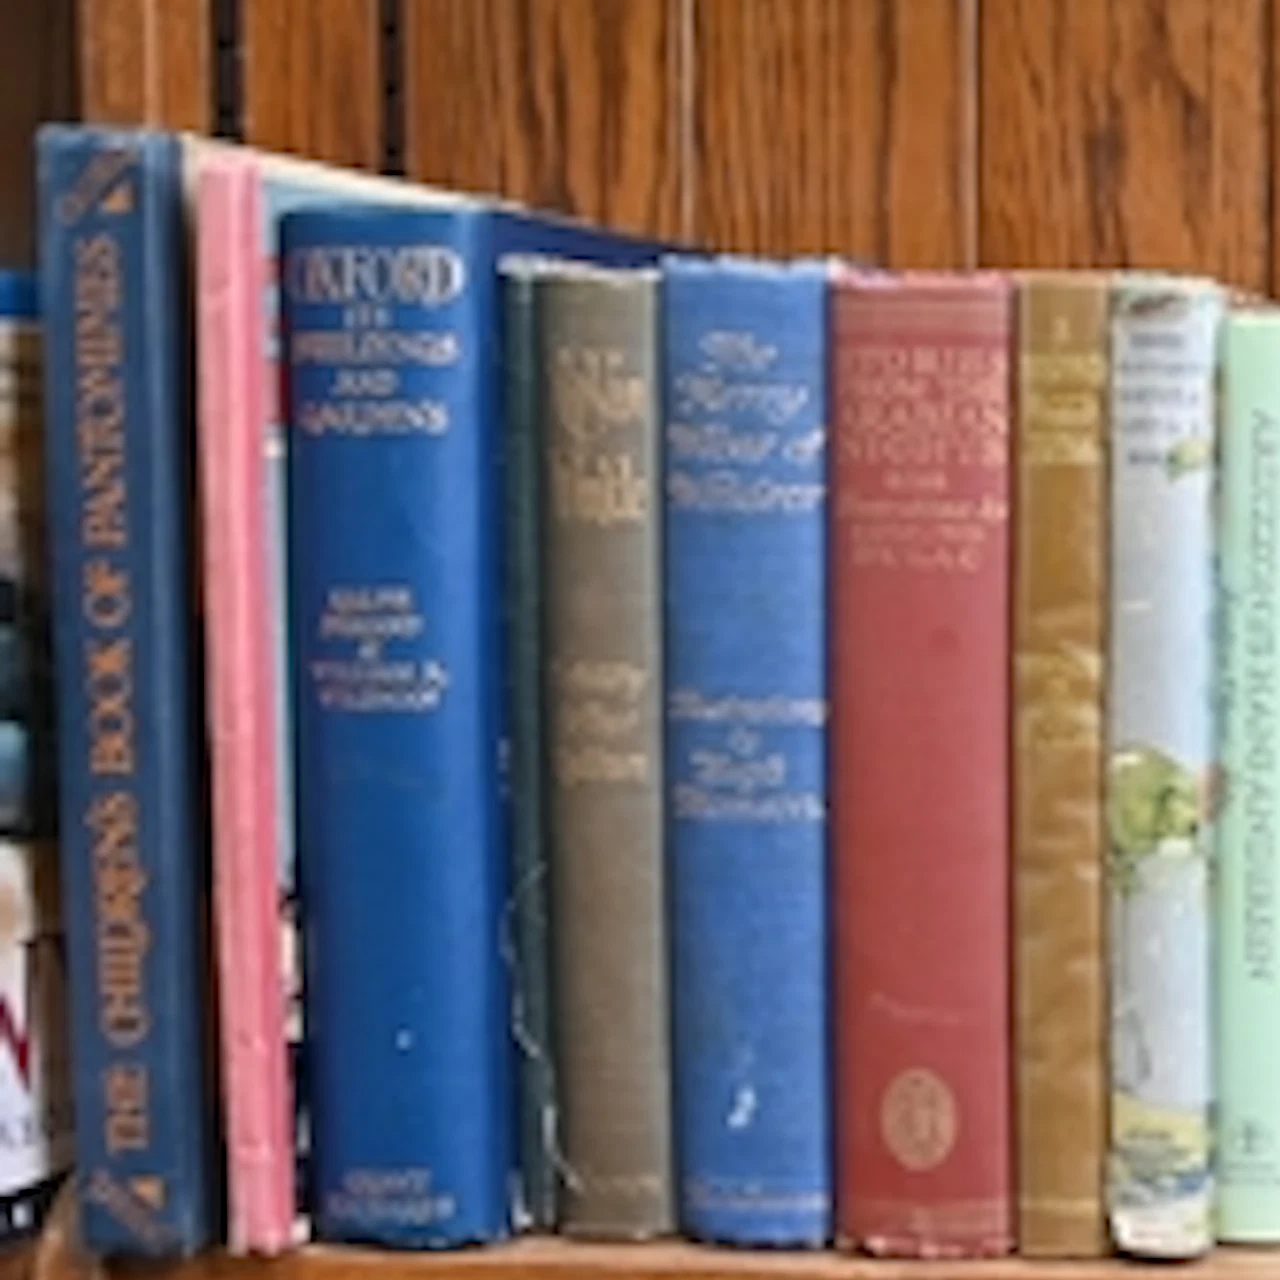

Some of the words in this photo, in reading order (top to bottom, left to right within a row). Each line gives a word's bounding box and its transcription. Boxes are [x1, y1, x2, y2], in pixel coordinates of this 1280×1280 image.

[291, 245, 467, 308] OXFORD
[75, 237, 129, 546] PANTOMIMES
[331, 372, 397, 395] AND
[83, 560, 131, 627] OF
[87, 638, 134, 774] BOOK
[86, 790, 151, 1048] CHILDREN'S
[106, 1062, 149, 1154] THE
